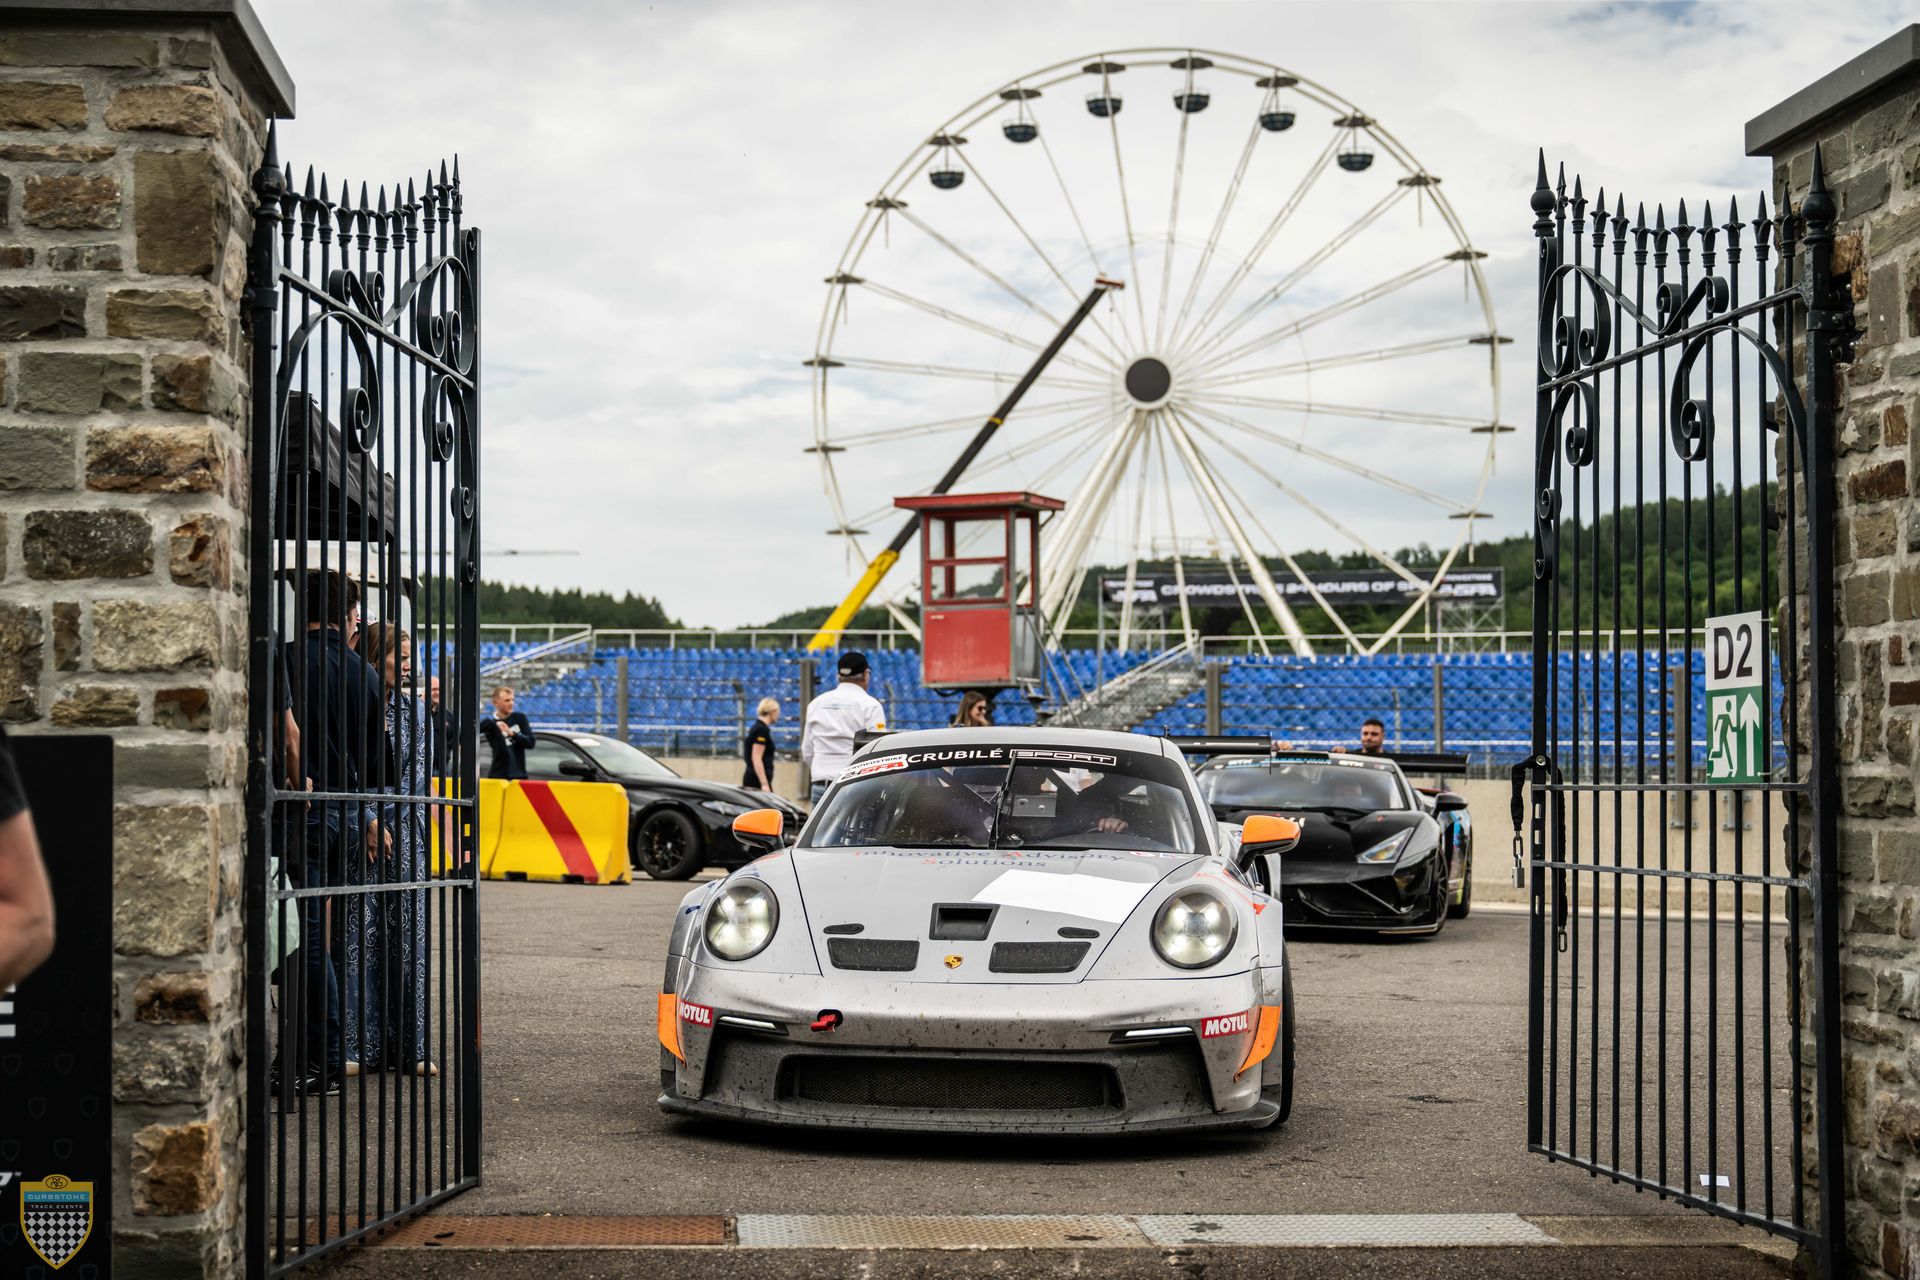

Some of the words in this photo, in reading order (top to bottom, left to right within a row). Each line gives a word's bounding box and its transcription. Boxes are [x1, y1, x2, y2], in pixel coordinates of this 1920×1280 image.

[1161, 583, 1285, 596] COWDSTRE
[1371, 580, 1395, 592] OF
[1713, 623, 1753, 680] D2
[907, 747, 1004, 763] CRUBILÉ
[1015, 750, 1113, 763] SPORT
[922, 858, 1047, 867] Solutions
[1003, 850, 1124, 861] Advisory
[680, 1001, 711, 1025] MOTUL
[1204, 1013, 1248, 1036] MOTUL
